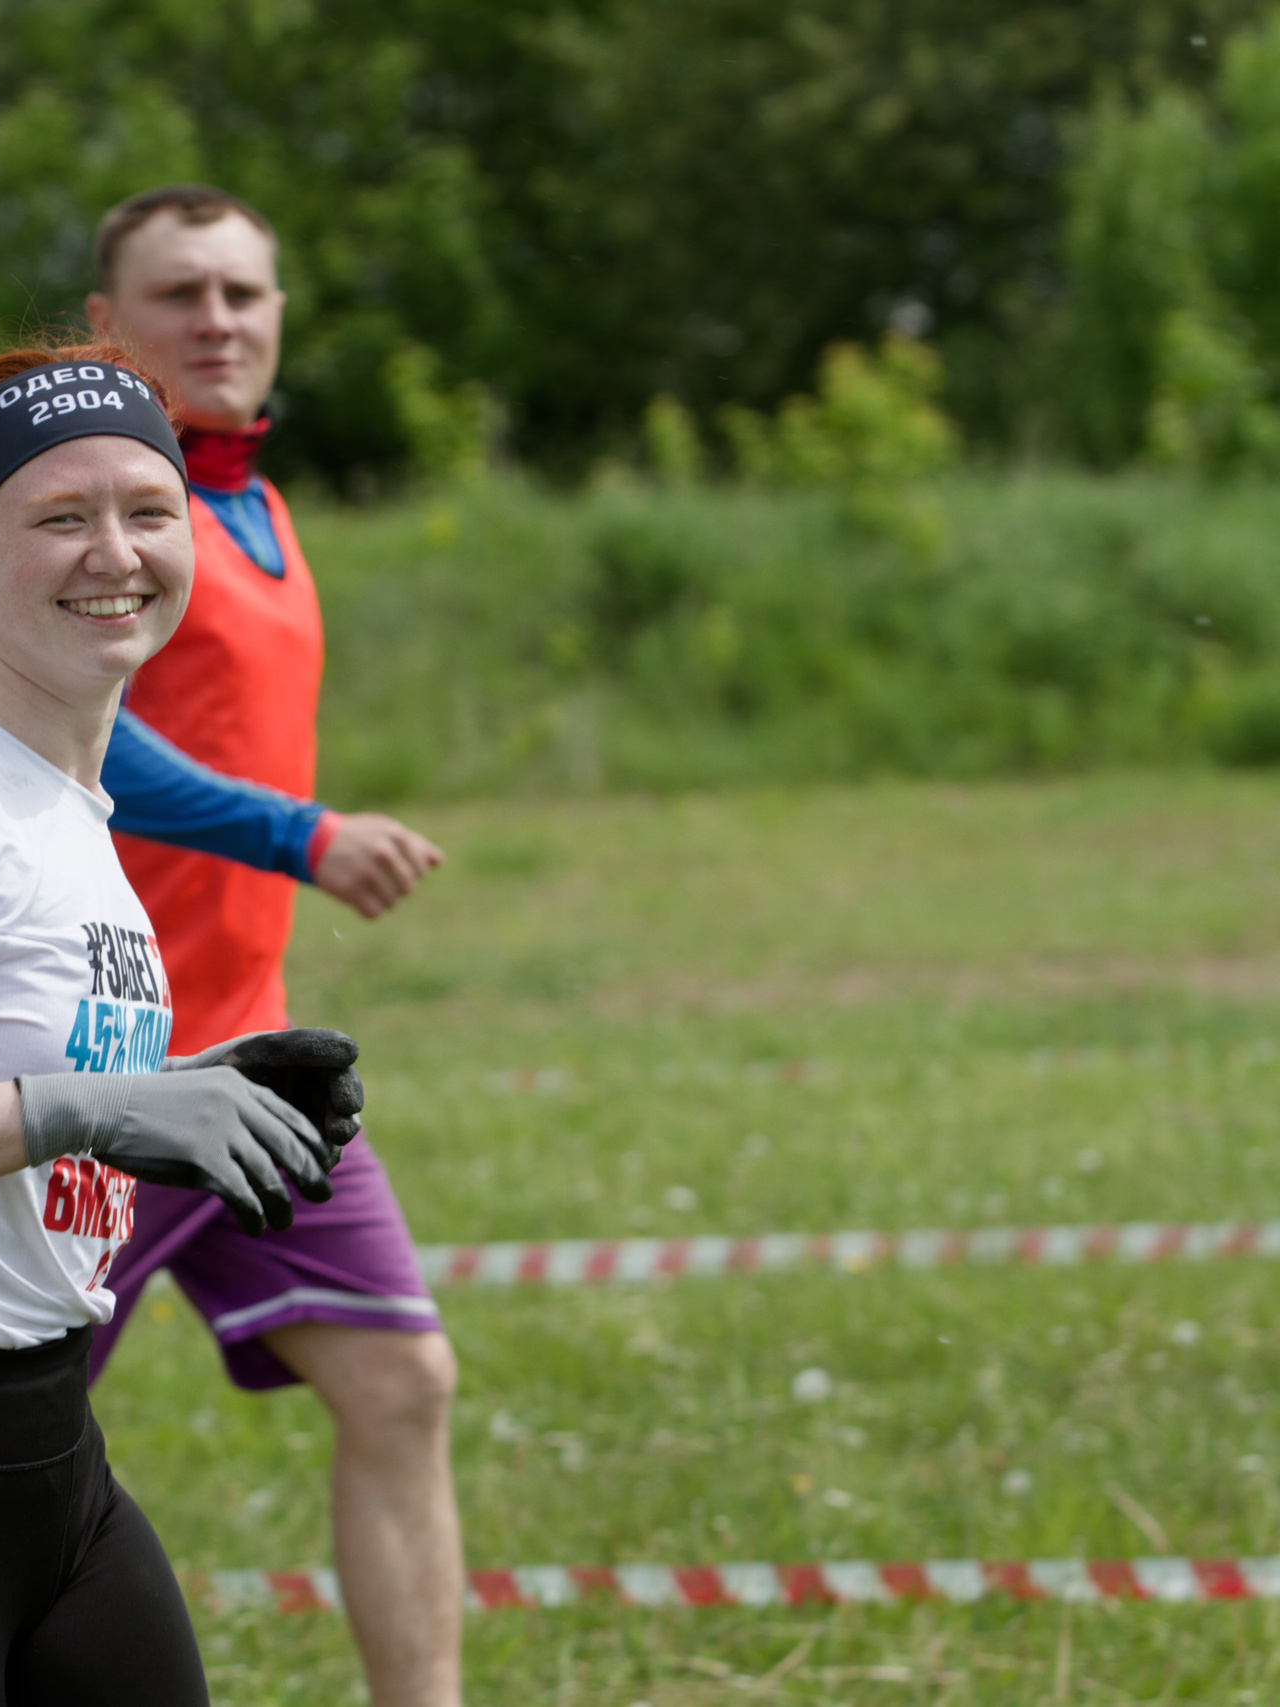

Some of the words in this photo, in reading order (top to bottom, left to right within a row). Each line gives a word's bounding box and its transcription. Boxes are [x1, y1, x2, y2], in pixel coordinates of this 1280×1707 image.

[116, 370, 150, 400] 59
[28, 390, 125, 426] 2904
[65, 999, 127, 1074] 45%
